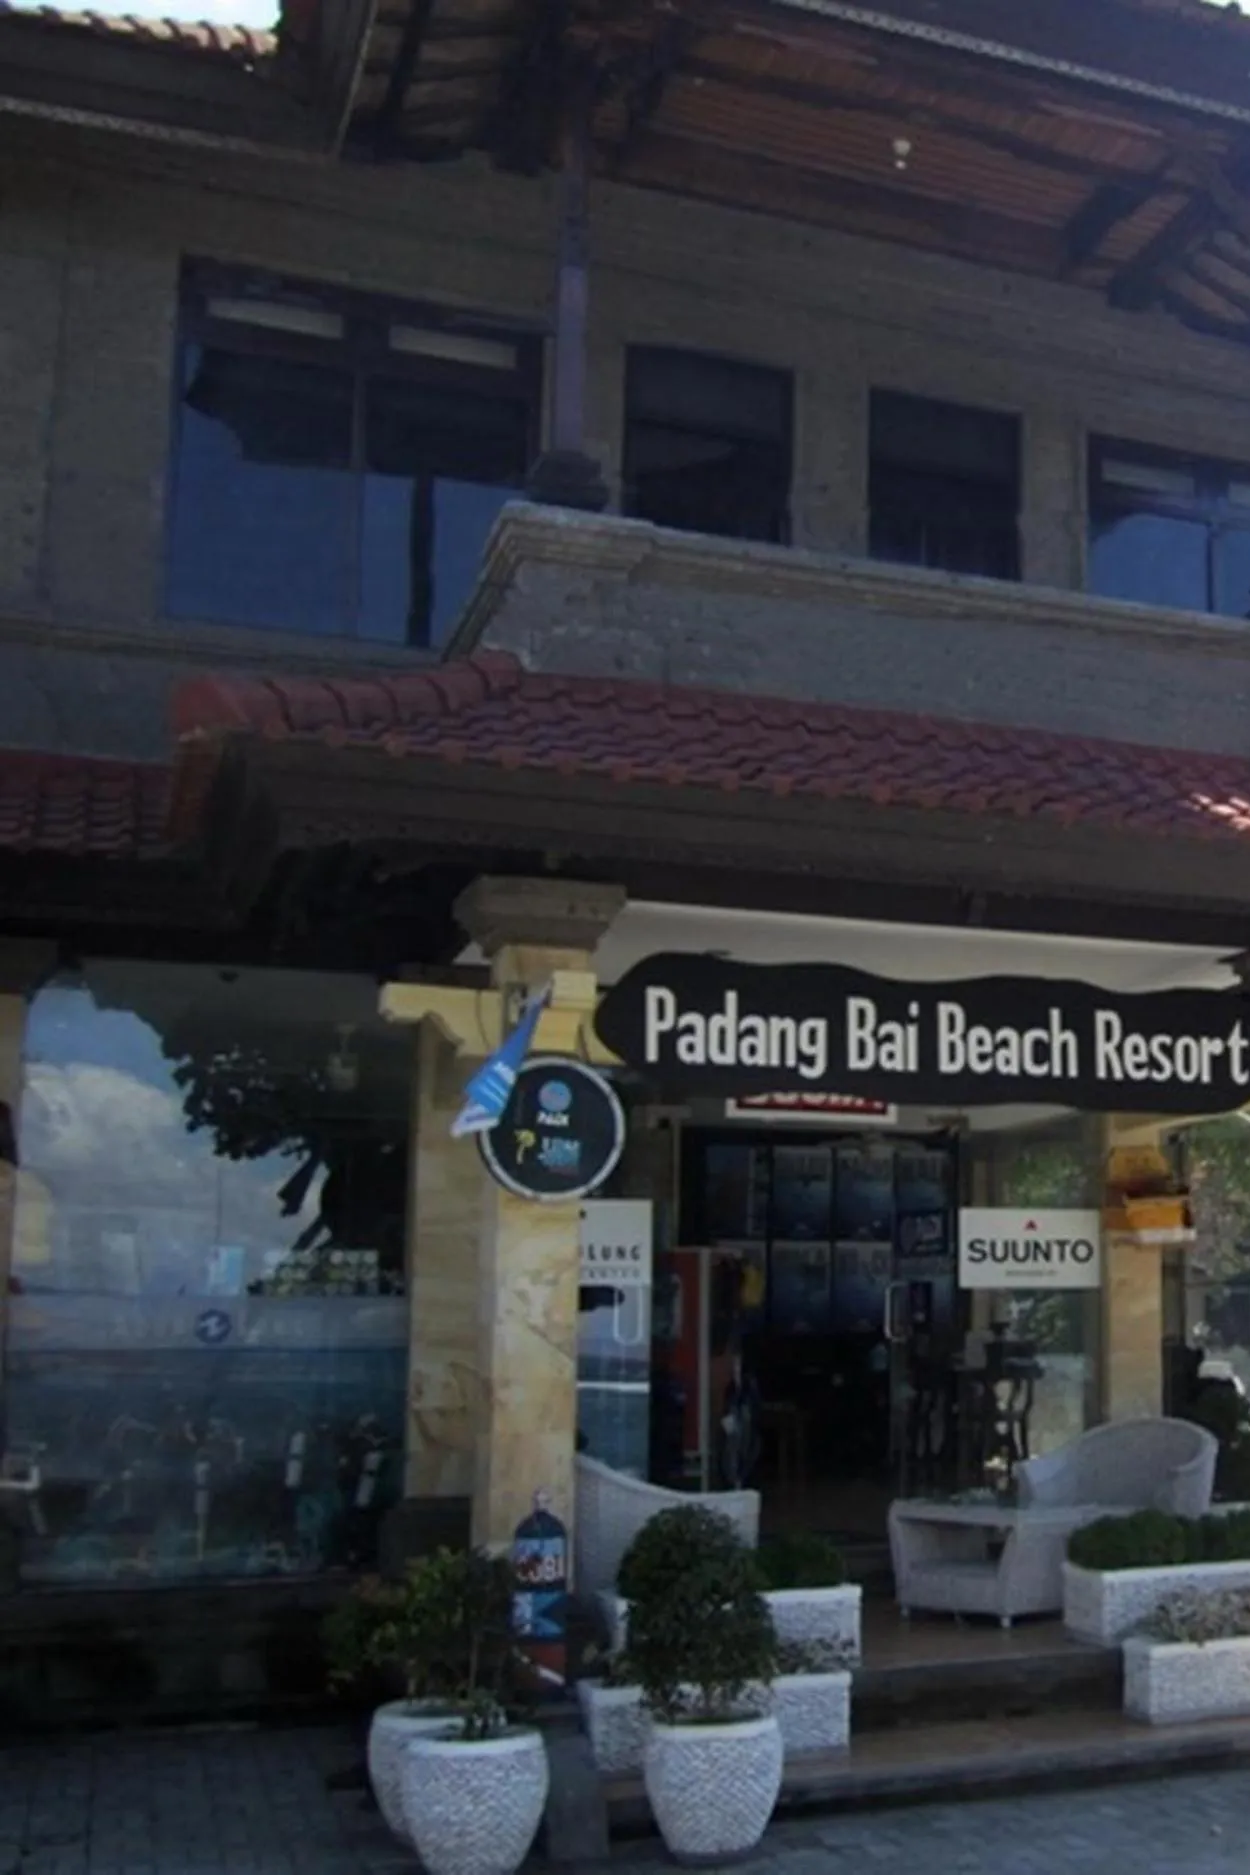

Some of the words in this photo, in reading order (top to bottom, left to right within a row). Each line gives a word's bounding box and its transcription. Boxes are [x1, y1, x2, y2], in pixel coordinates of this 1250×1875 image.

[644, 985, 827, 1079] Padang
[846, 996, 921, 1074] Bai
[936, 1001, 1080, 1078] Beach
[1094, 1009, 1250, 1086] Resort
[966, 1237, 1094, 1264] SUUNTO
